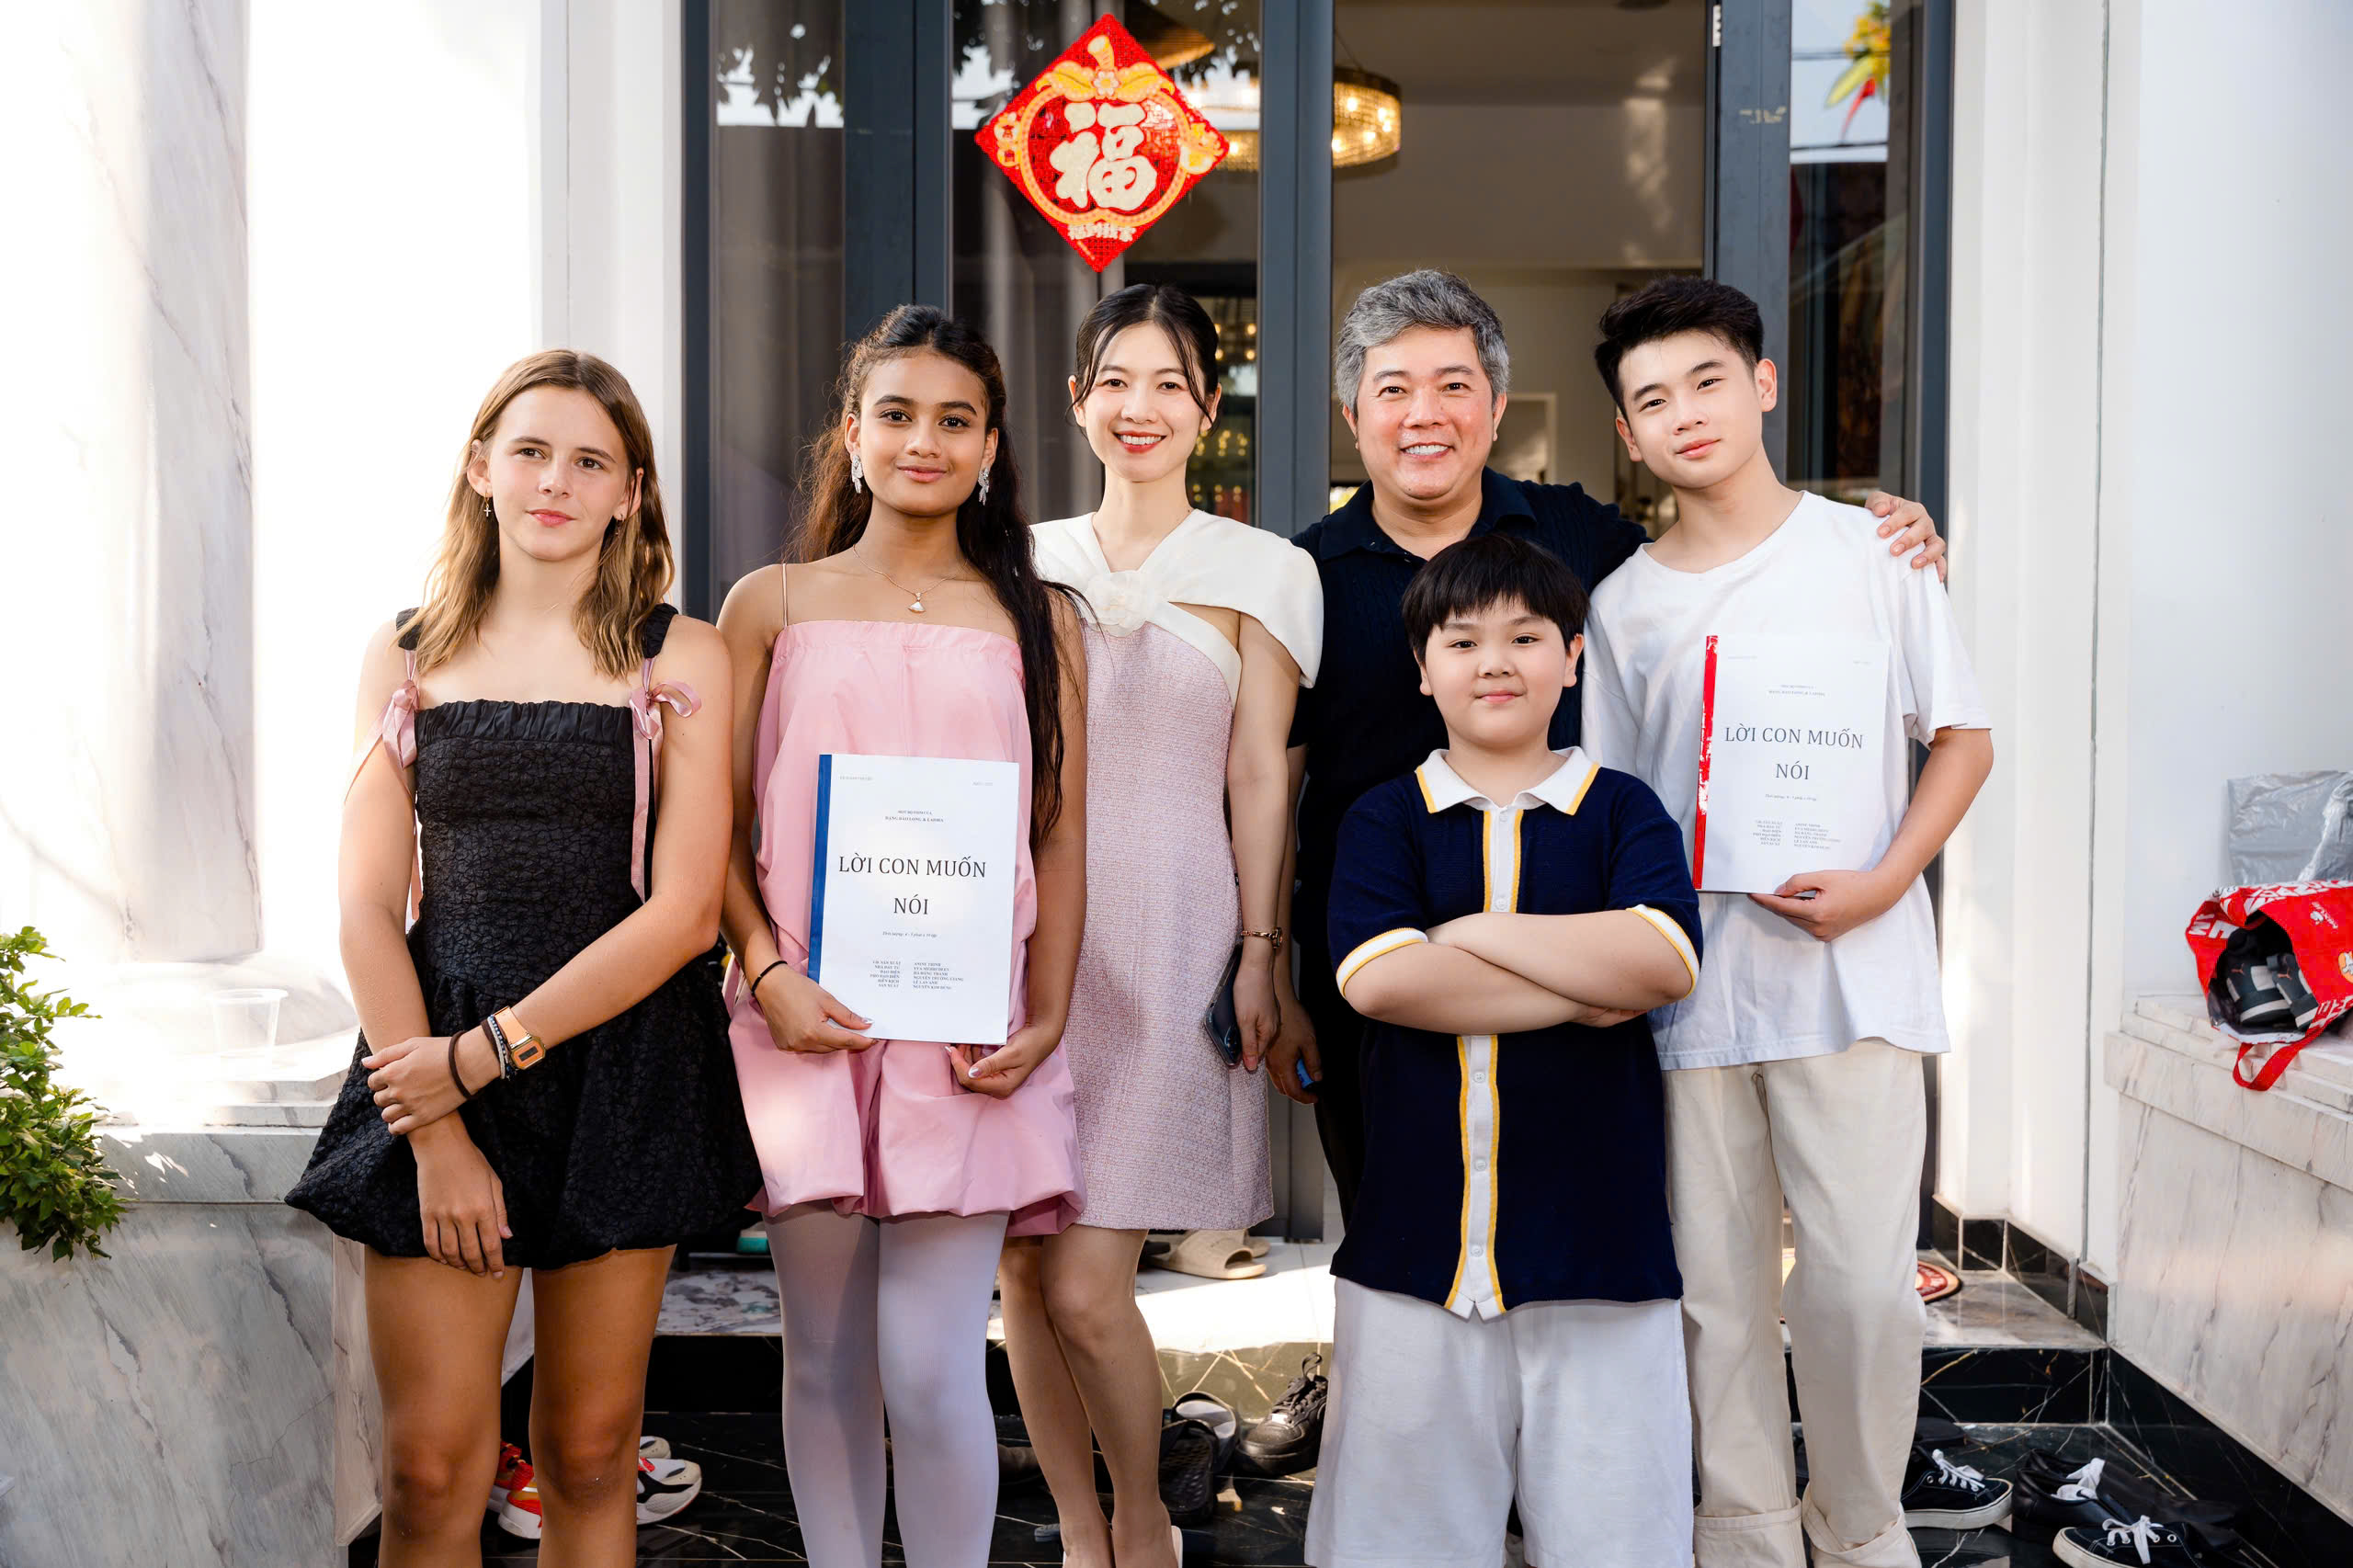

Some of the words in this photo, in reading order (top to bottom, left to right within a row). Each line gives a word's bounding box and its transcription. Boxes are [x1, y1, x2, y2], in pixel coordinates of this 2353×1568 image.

[1050, 101, 1157, 211] 福
[1724, 722, 1756, 742] LỜI
[1762, 727, 1802, 744] CON
[1807, 728, 1863, 749] MUỐN
[1775, 760, 1810, 780] NÓI
[838, 852, 872, 873] LỜI
[879, 858, 919, 875] CON
[926, 855, 986, 878] MUỐN
[893, 893, 928, 915] NÓI
